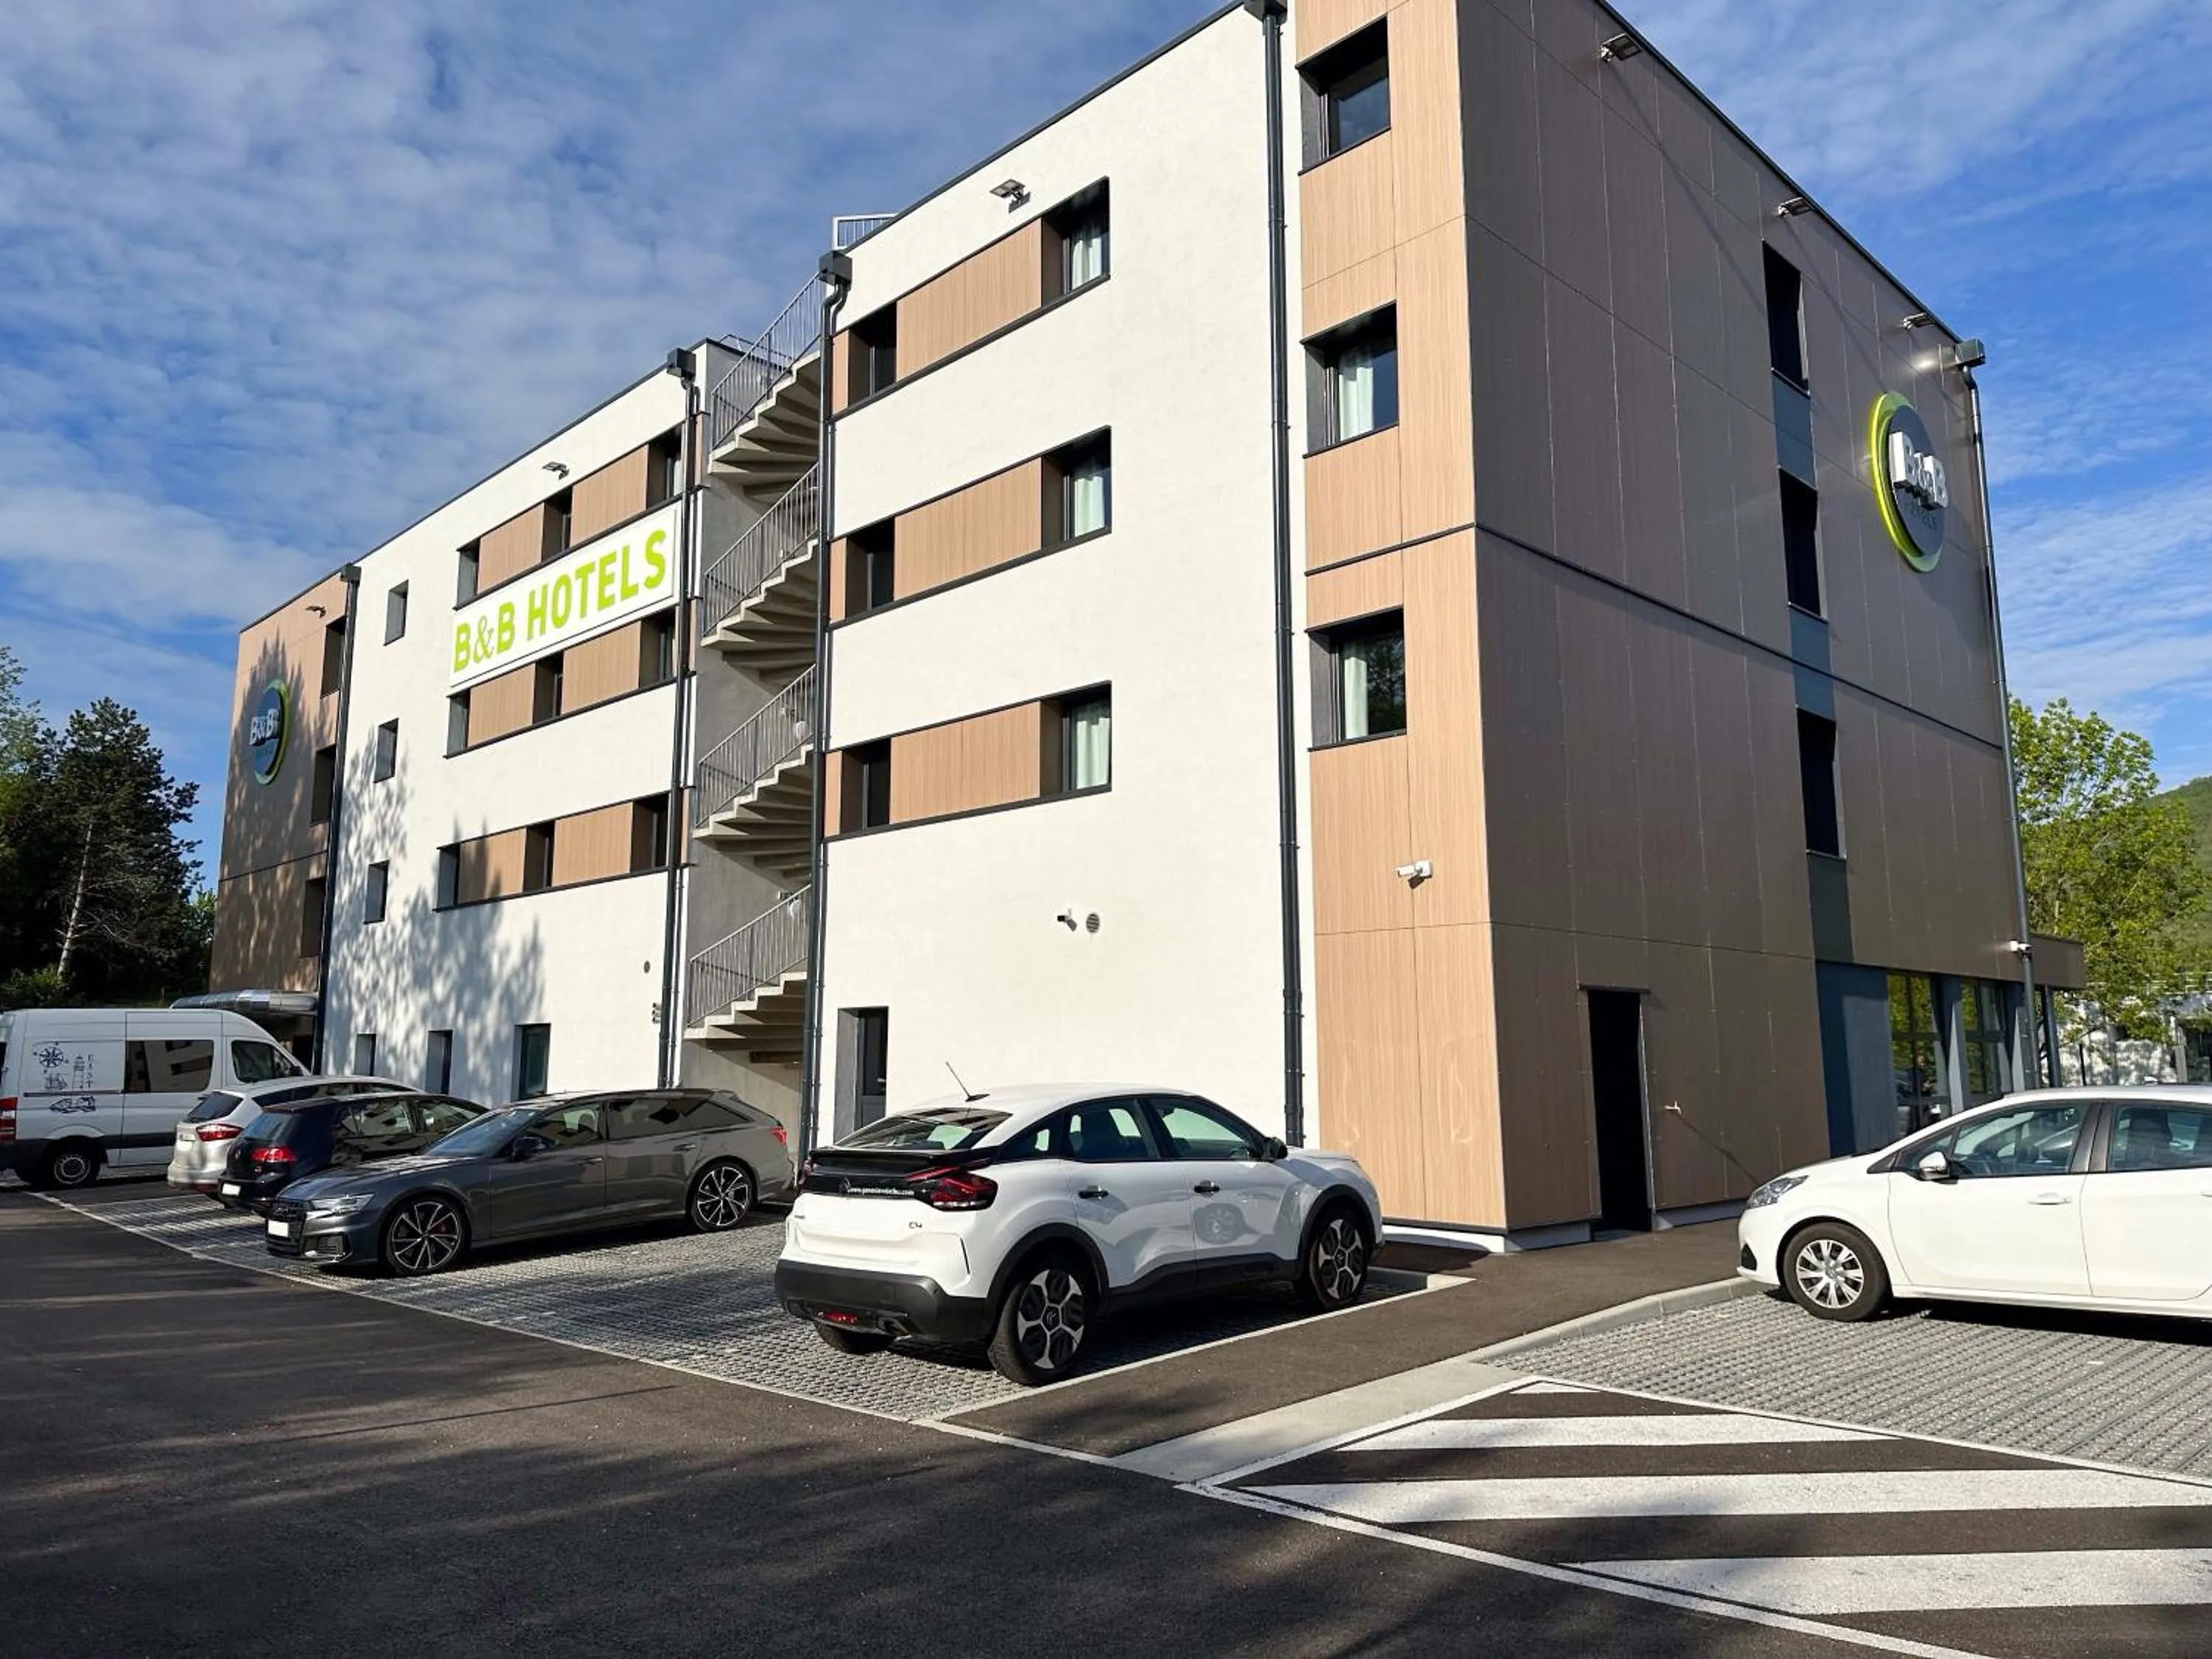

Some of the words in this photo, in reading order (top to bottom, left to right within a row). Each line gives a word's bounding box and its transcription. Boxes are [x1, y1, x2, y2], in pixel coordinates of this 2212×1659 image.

[453, 601, 515, 673] B&B
[527, 529, 667, 641] HOTELS
[249, 708, 276, 746] B&B
[908, 1221, 922, 1229] C4
